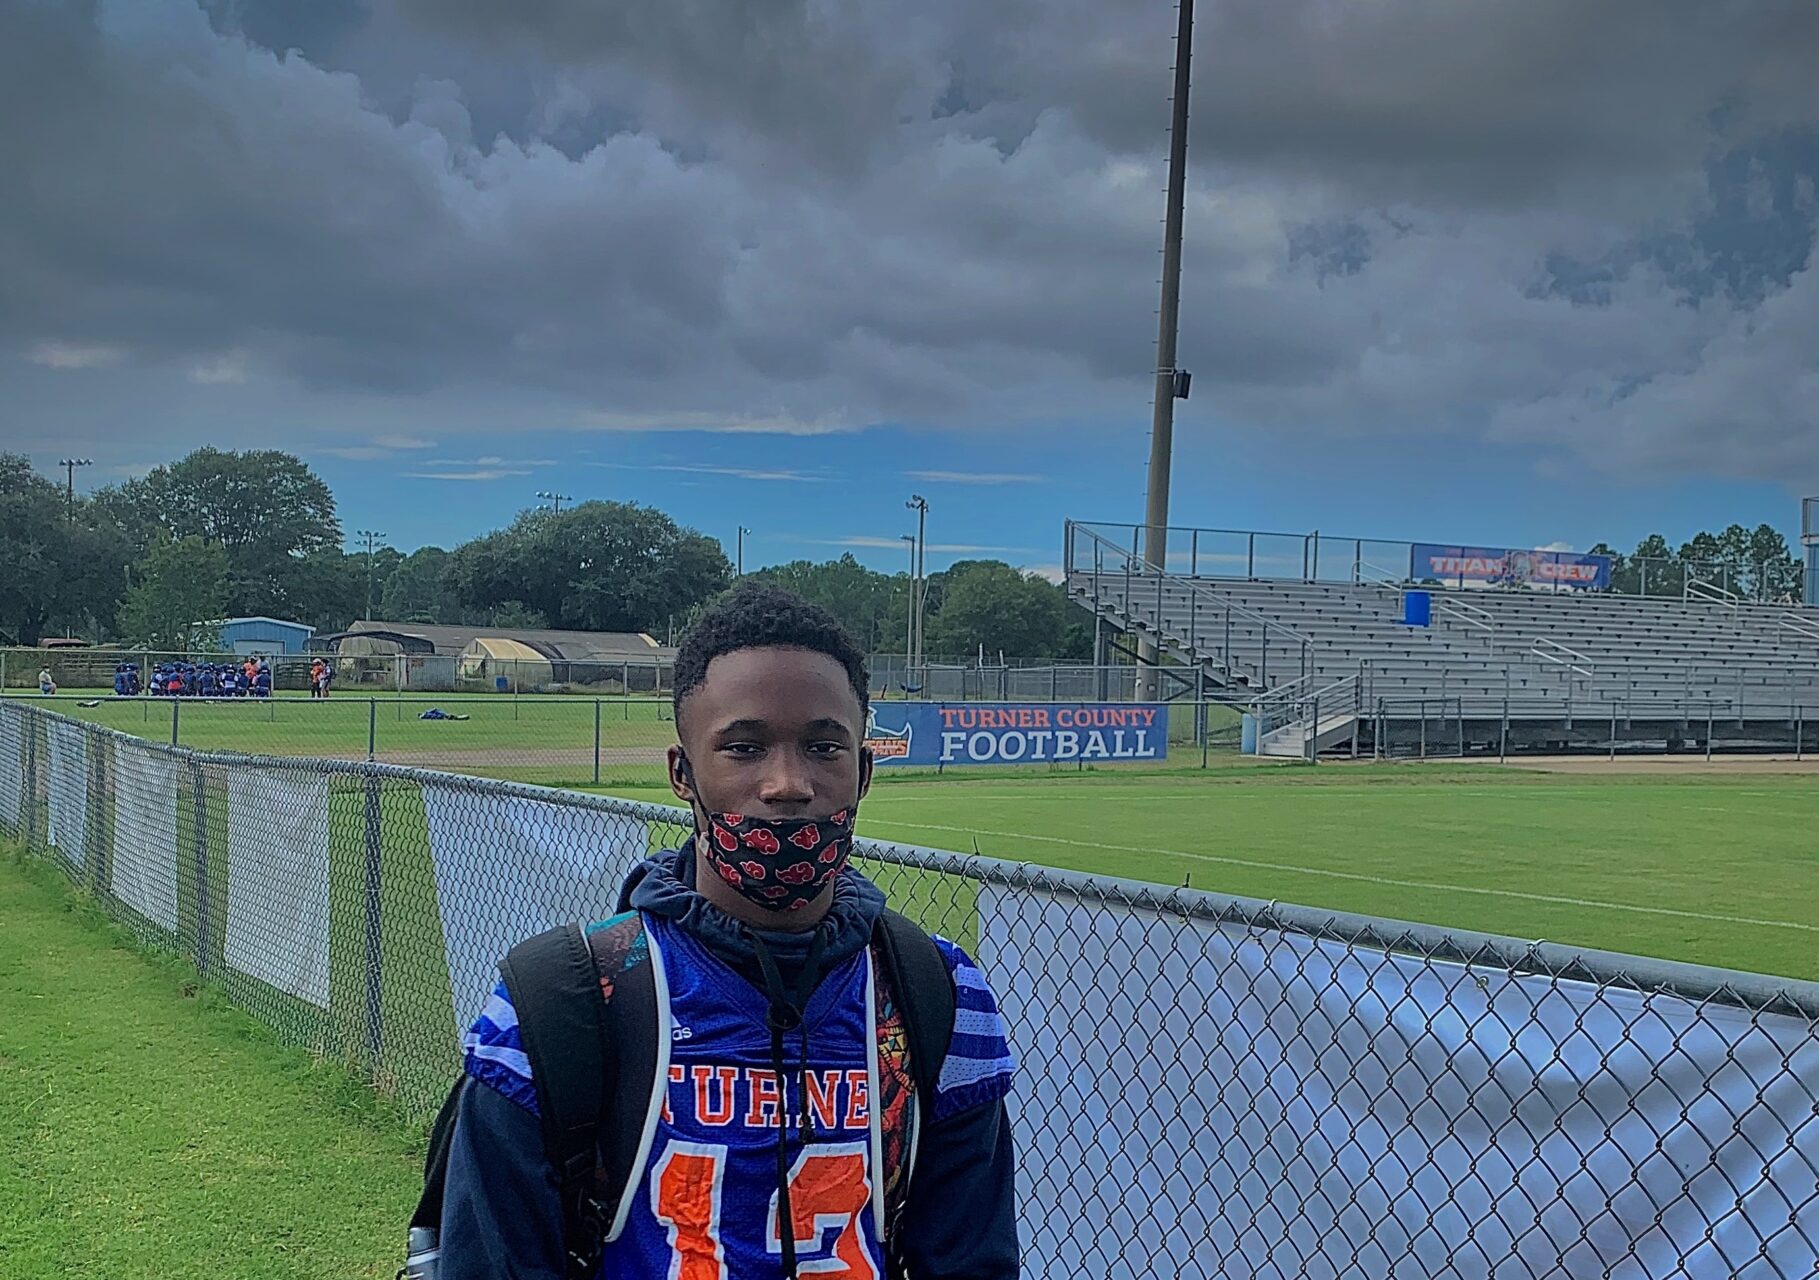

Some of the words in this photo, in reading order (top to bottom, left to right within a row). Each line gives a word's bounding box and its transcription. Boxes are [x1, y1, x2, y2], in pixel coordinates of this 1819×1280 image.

[1538, 563, 1598, 580] CREW
[939, 708, 1050, 728] TURNER
[1056, 708, 1157, 727] COUNTY
[939, 730, 1155, 761] FOOTBALL
